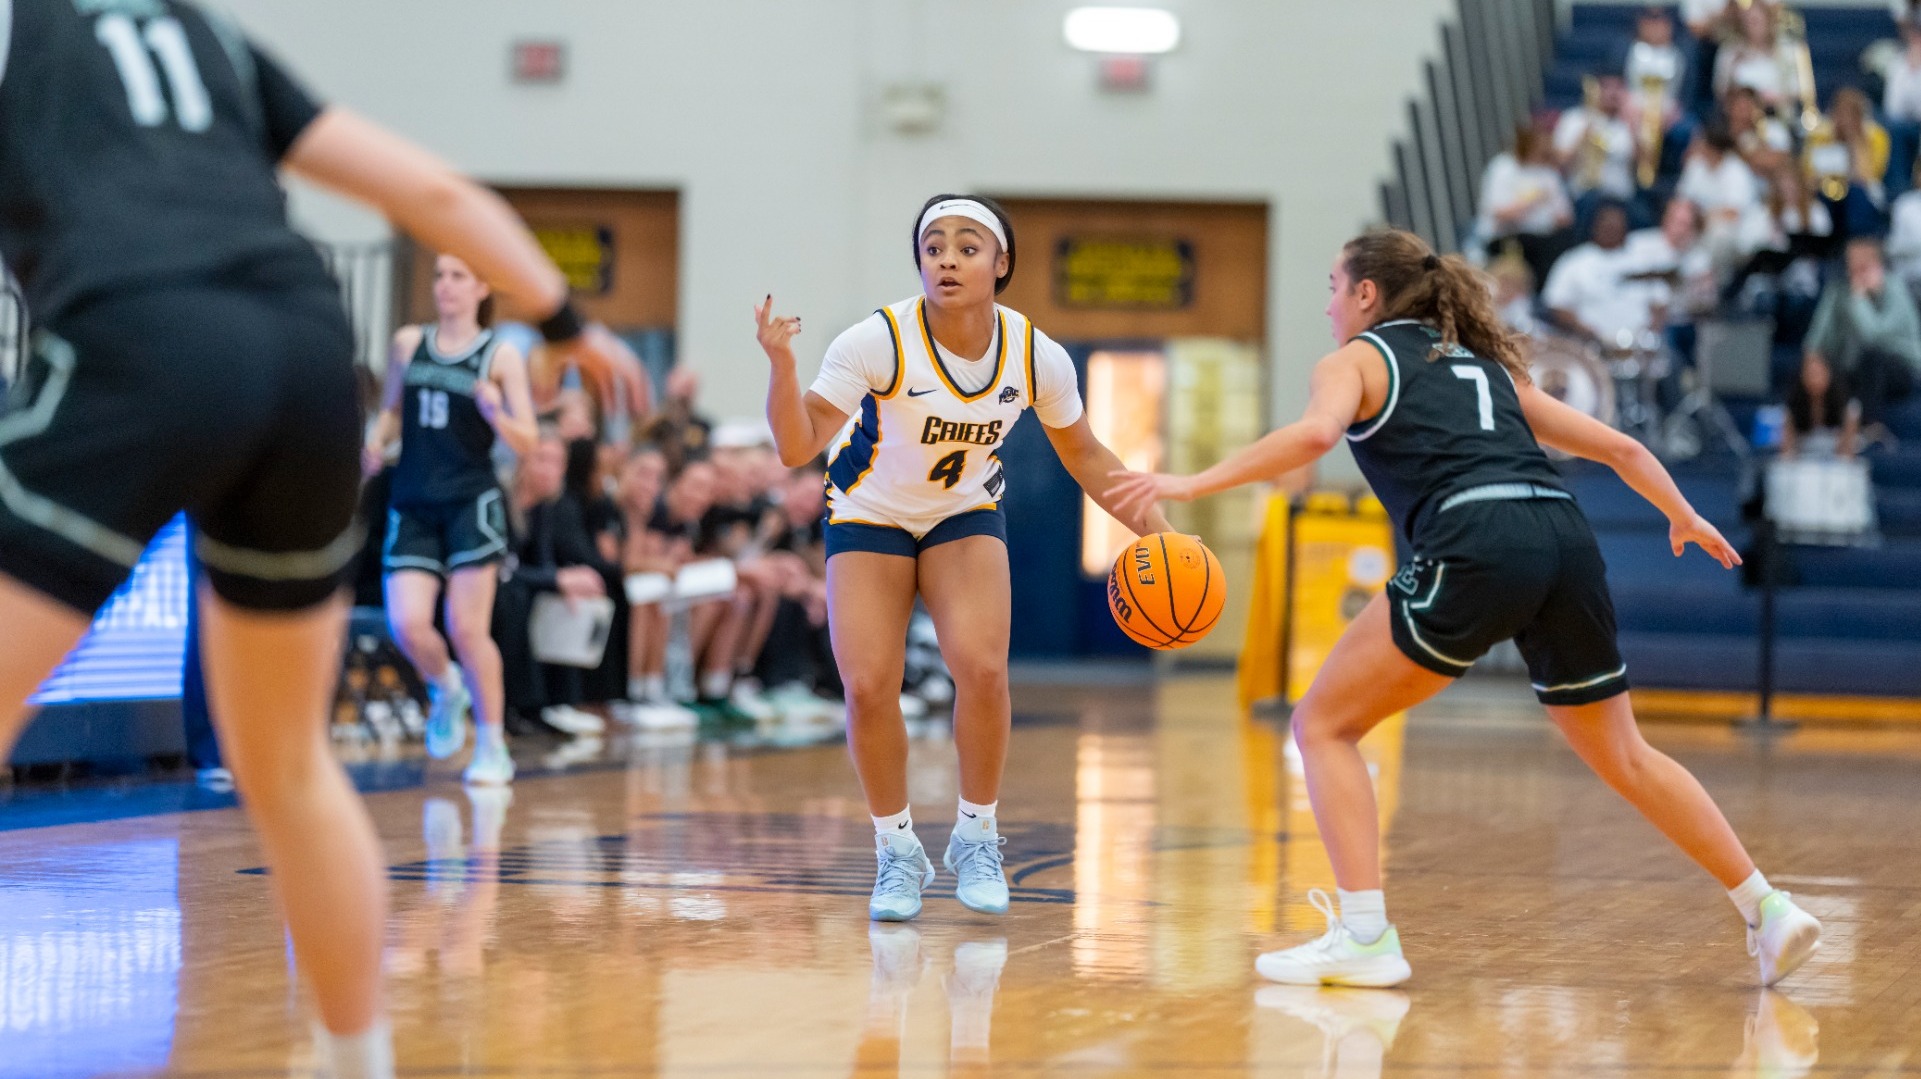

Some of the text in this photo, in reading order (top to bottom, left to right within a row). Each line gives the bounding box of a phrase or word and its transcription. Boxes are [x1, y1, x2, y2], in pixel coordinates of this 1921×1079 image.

[94, 14, 213, 133] 11
[1450, 365, 1495, 431] 7
[920, 416, 1003, 446] GRIFFS
[927, 449, 969, 490] 4
